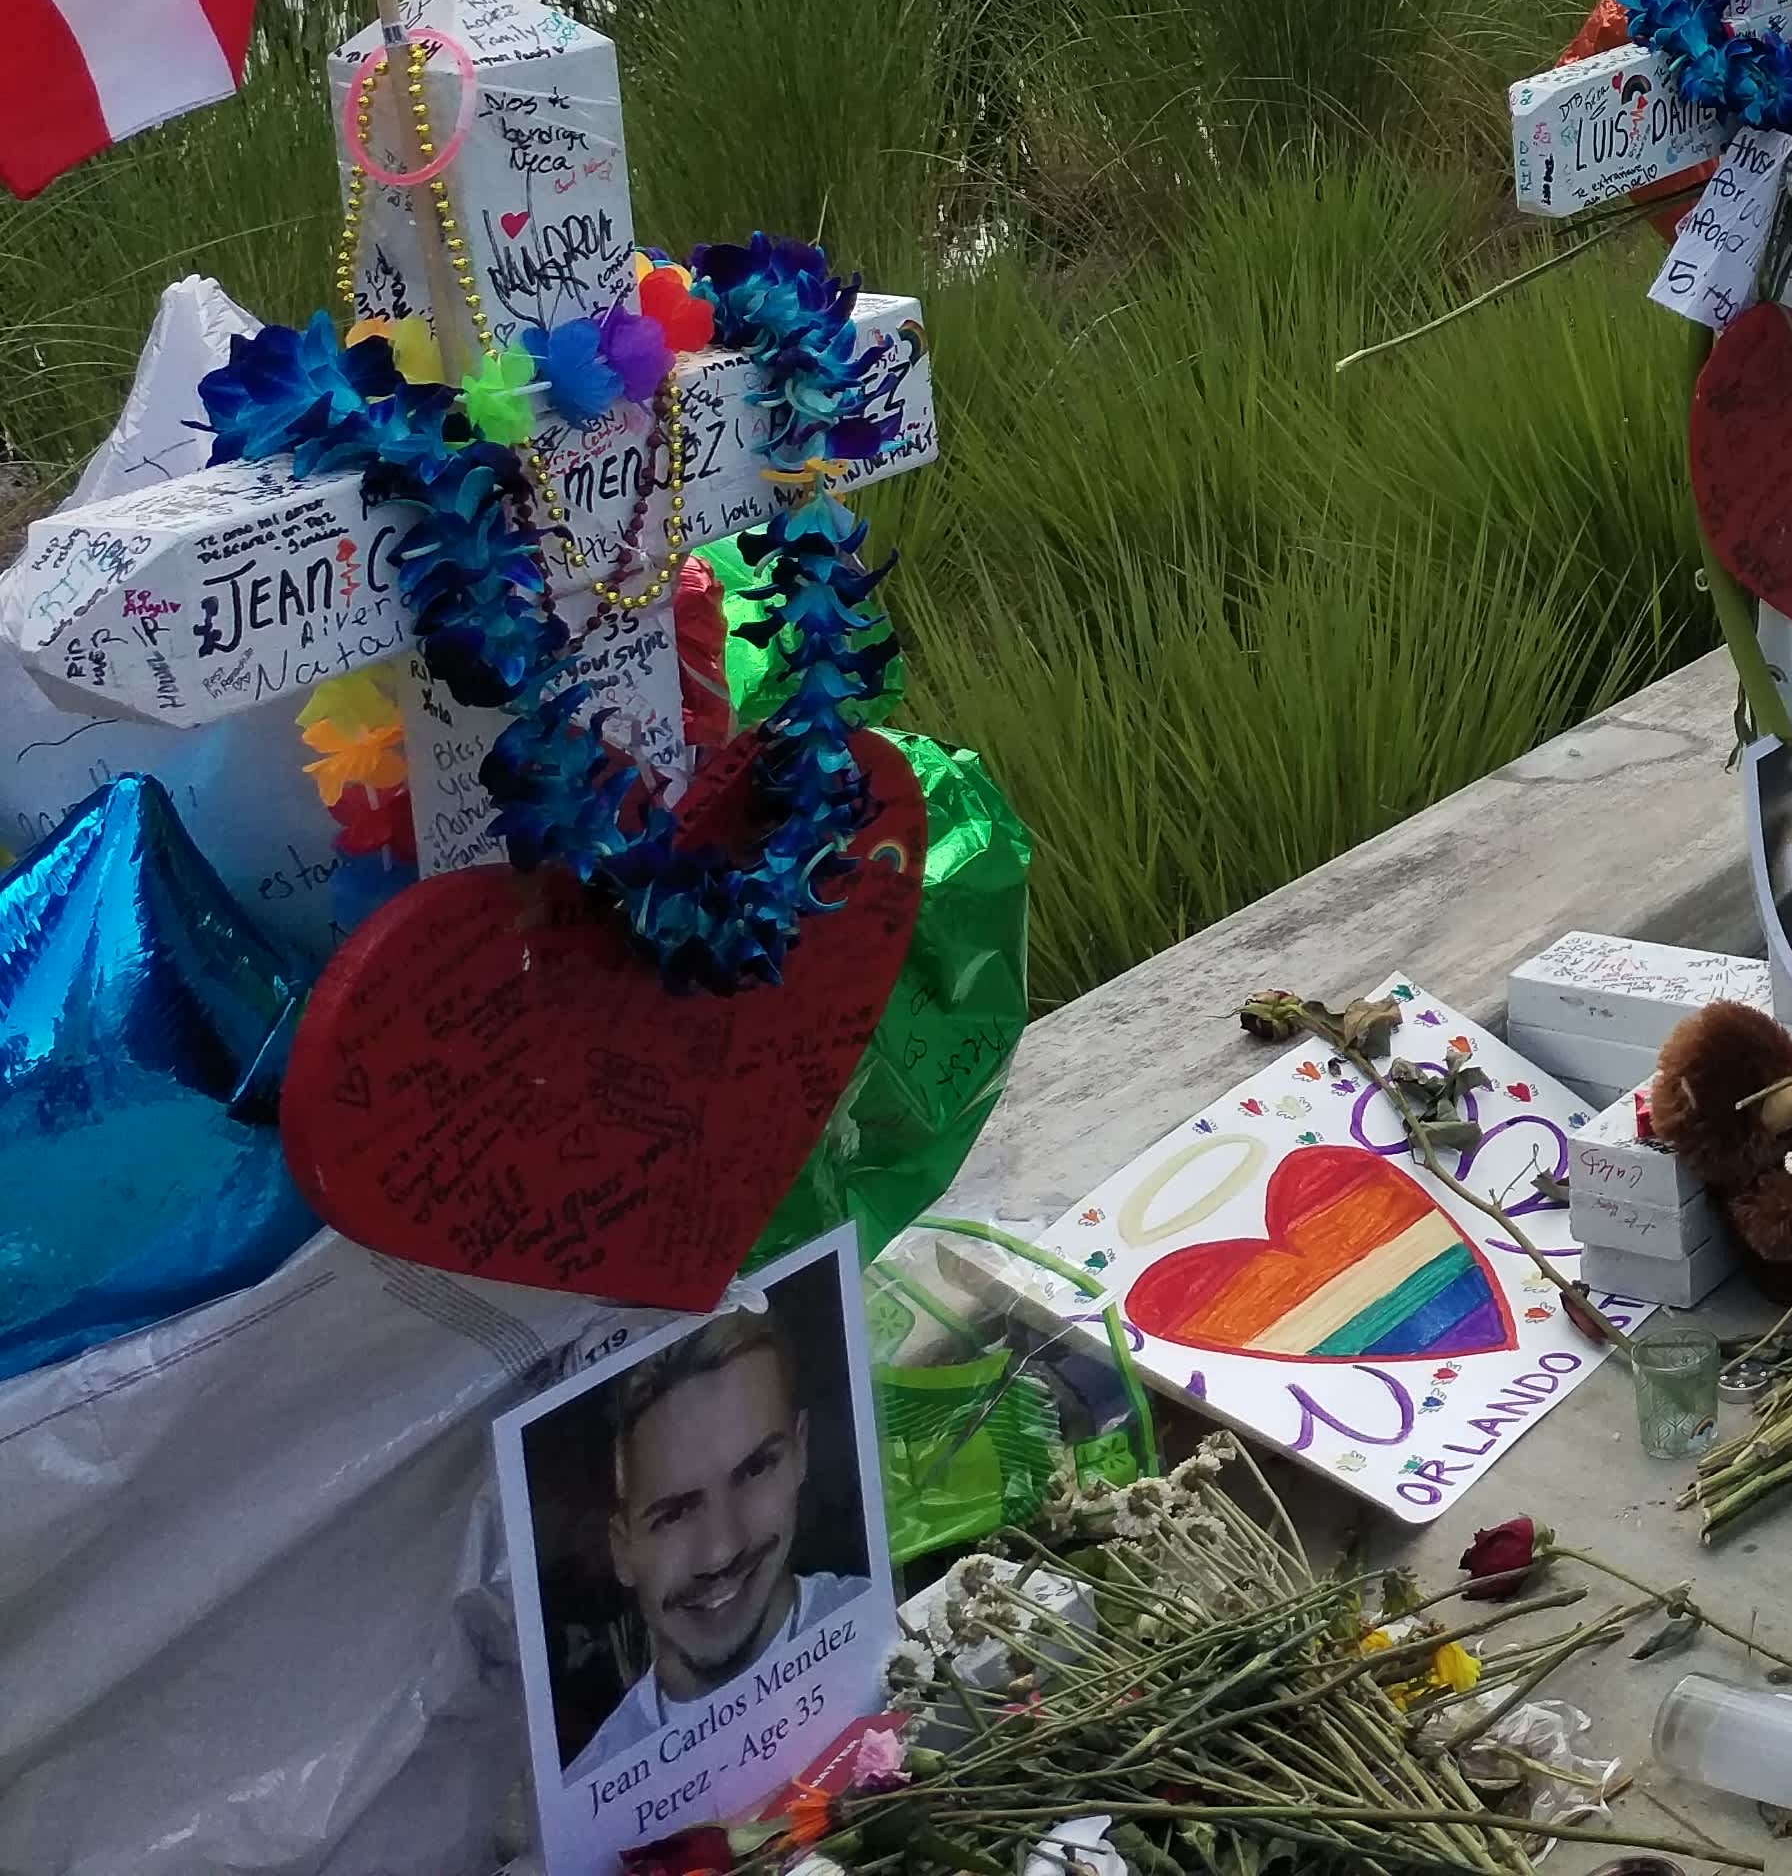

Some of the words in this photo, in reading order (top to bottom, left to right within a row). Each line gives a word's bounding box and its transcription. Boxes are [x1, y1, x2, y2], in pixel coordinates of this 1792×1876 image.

[1396, 1351, 1582, 1506] ORLANDO
[589, 1759, 651, 1817] Jean
[656, 1696, 749, 1767] Carlos
[752, 1617, 859, 1705] Mendez
[635, 1771, 712, 1836] Perez
[737, 1721, 791, 1782] Age
[796, 1684, 827, 1730] 35
